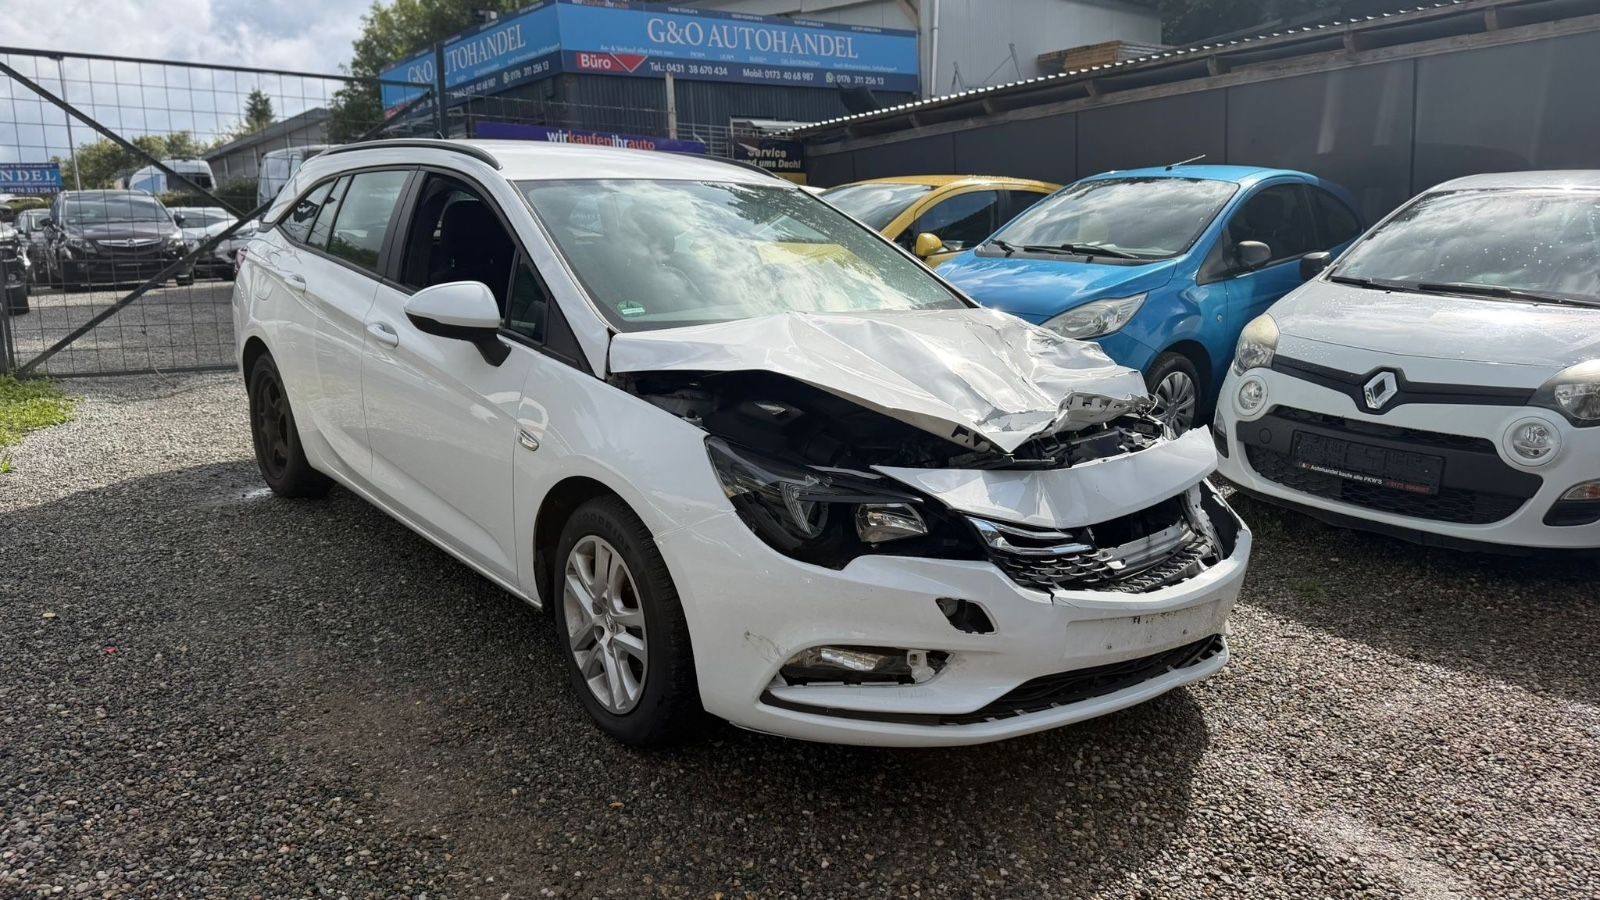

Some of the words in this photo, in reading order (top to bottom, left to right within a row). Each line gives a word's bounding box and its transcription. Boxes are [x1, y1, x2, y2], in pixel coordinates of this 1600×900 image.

[647, 18, 704, 46] G&O
[708, 24, 859, 59] AUTOHANDEL
[407, 59, 433, 84] G&O
[438, 24, 527, 78] UTOHANDEL
[580, 53, 612, 70] Büro
[666, 64, 685, 73] 0431
[688, 65, 698, 74] 38
[699, 66, 713, 75] 670
[713, 66, 728, 76] 434
[742, 68, 764, 79] Mobil:
[764, 70, 781, 80] 0173
[783, 72, 792, 80] 40
[802, 73, 814, 82] 987
[854, 76, 864, 84] 311
[865, 76, 876, 85] 256
[877, 77, 885, 85] 13
[546, 129, 656, 150] wirkaufenihrauto
[778, 160, 801, 168] Dach!
[1311, 465, 1338, 475] Autohandel
